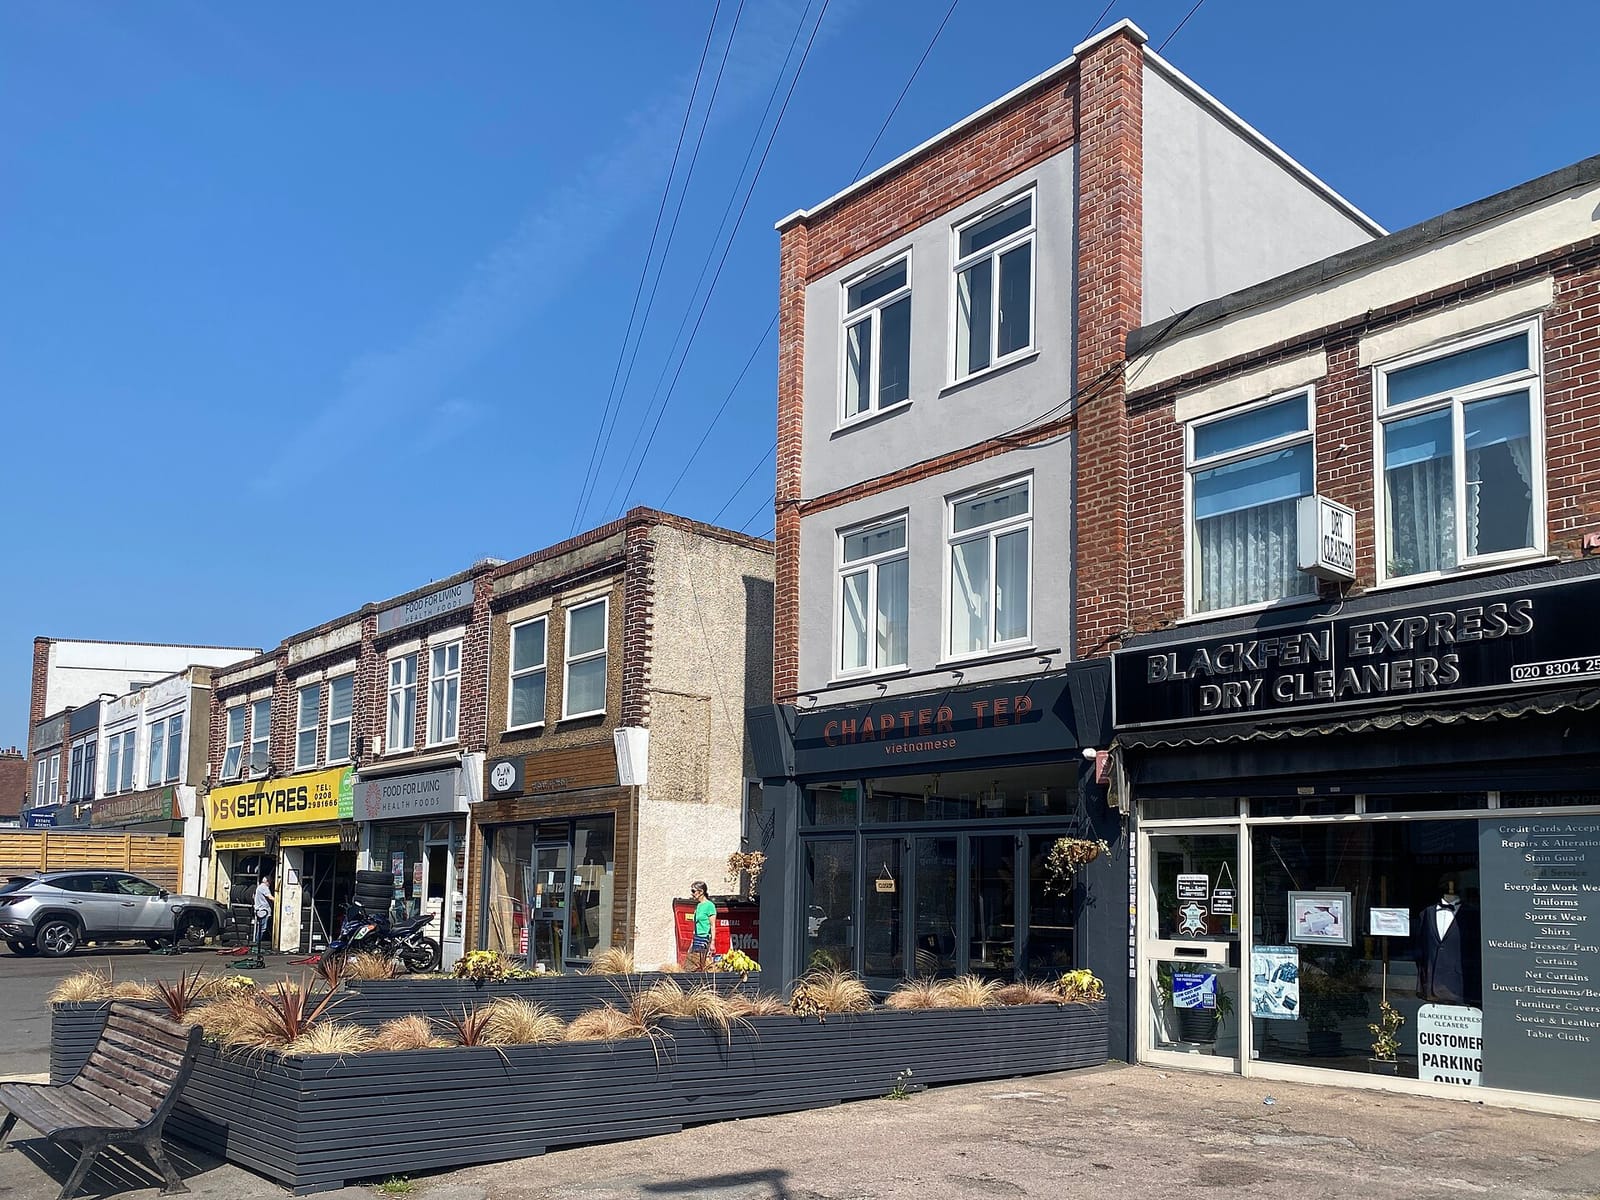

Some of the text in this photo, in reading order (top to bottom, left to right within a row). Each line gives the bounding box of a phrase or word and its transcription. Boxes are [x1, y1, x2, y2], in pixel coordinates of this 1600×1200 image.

[405, 586, 462, 614] FOOD FOR LIVING
[405, 599, 462, 622] HEALTH FOODS
[1147, 599, 1534, 684] BLACKFEN EXPRESS
[1515, 666, 1540, 679] 020
[1545, 661, 1580, 676] 8304
[1199, 653, 1460, 711] DRY CLEANERS
[824, 706, 953, 747] CHAPTER
[885, 737, 958, 754] vietnamese
[382, 780, 440, 797] FOOD FOR LIVING
[237, 786, 308, 817] SETYRES
[314, 792, 332, 801] 0208
[307, 799, 338, 809] 2981666
[382, 797, 440, 811] HEALTH FOODS
[1501, 840, 1538, 849] Repairs
[1553, 839, 1600, 847] Alteratio
[1504, 883, 1548, 892] Everyday
[1551, 883, 1578, 891] Work
[1532, 898, 1579, 906] Uniforms
[1524, 912, 1588, 921] Sports Wear
[1541, 927, 1571, 936] Shirts
[731, 933, 759, 949] Biffa
[1488, 940, 1600, 953] Wedding Dresses/ Party
[1535, 956, 1578, 966] Curtains
[1525, 970, 1589, 982] Net Curtains
[1492, 983, 1600, 997] Duvets/Eiderdowns/Be
[1515, 999, 1600, 1012] Furniture Covers
[1420, 1013, 1452, 1021] BLACKFEN
[1515, 1013, 1545, 1023] Suede
[1434, 1021, 1469, 1029] CLEANERS
[1420, 1032, 1483, 1050] CUSTOMER
[1526, 1029, 1591, 1042] Table Cloths
[1422, 1053, 1483, 1072] PARKING
